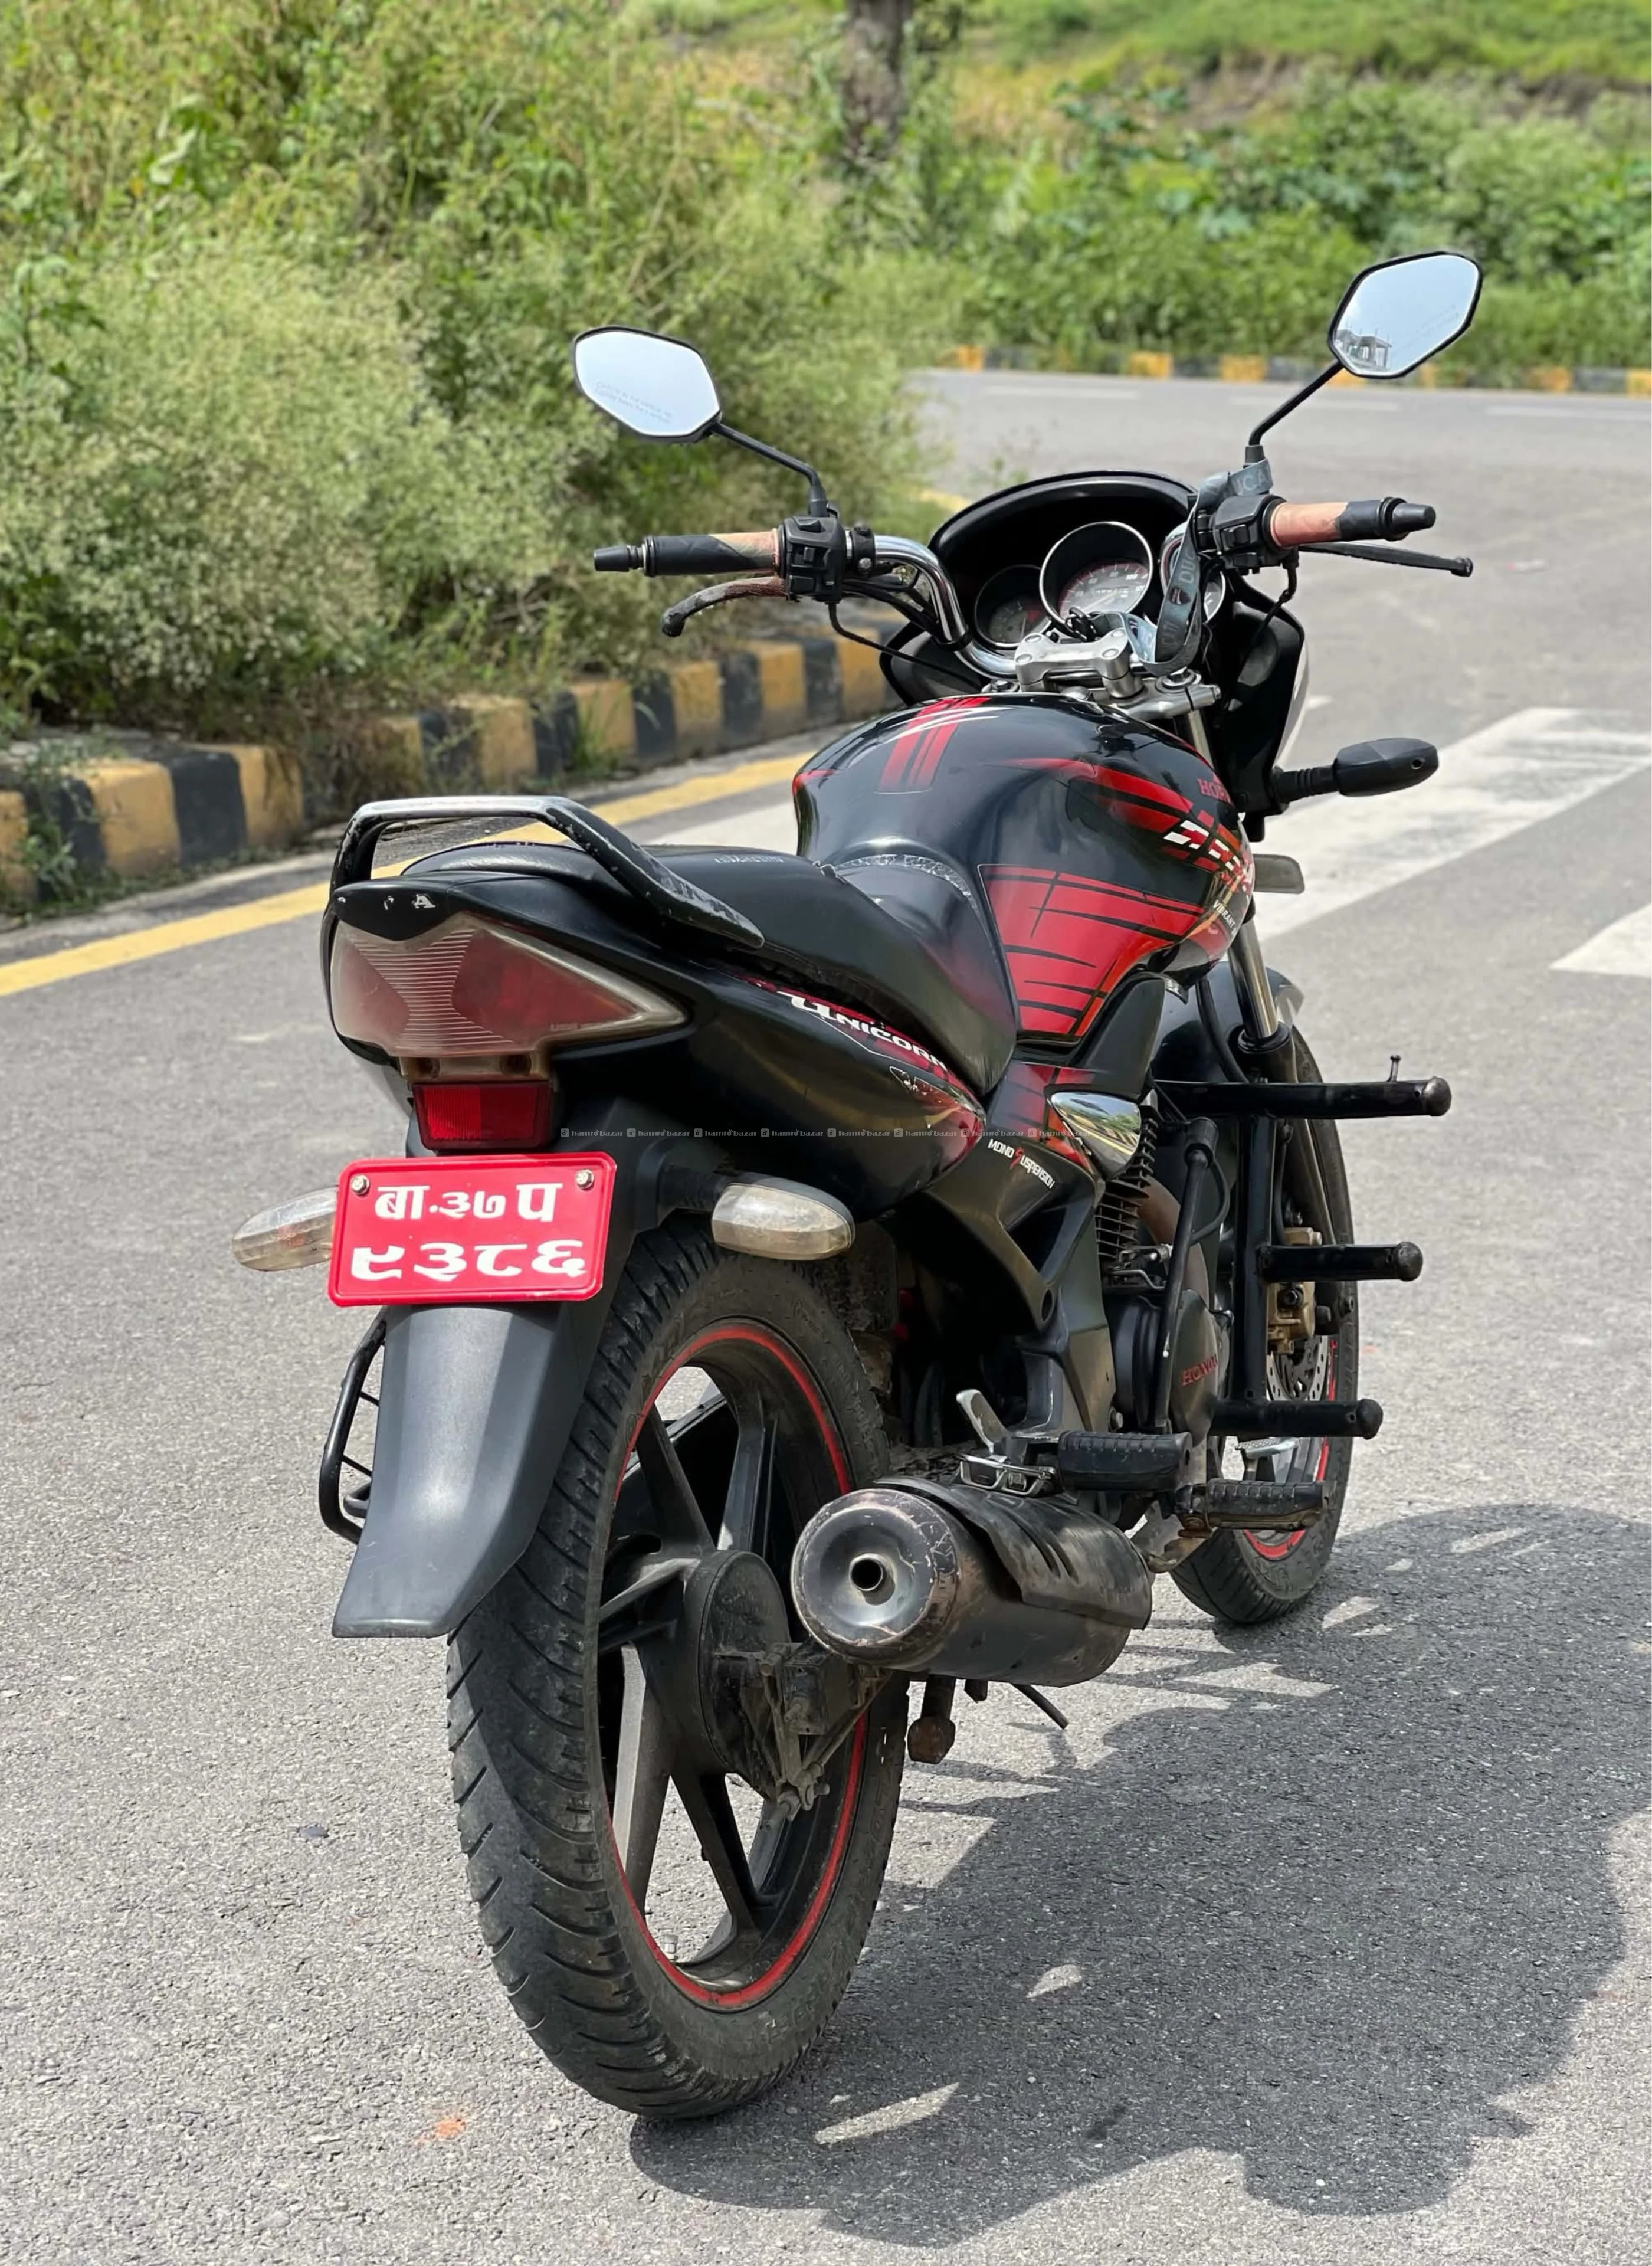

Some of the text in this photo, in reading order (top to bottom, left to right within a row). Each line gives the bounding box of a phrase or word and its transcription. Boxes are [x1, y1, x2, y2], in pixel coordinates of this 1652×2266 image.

[1197, 778, 1231, 804] HON
[988, 1138, 1015, 1159] MONO
[350, 1239, 588, 1282] ५३८६
[1182, 1353, 1218, 1387] HON
